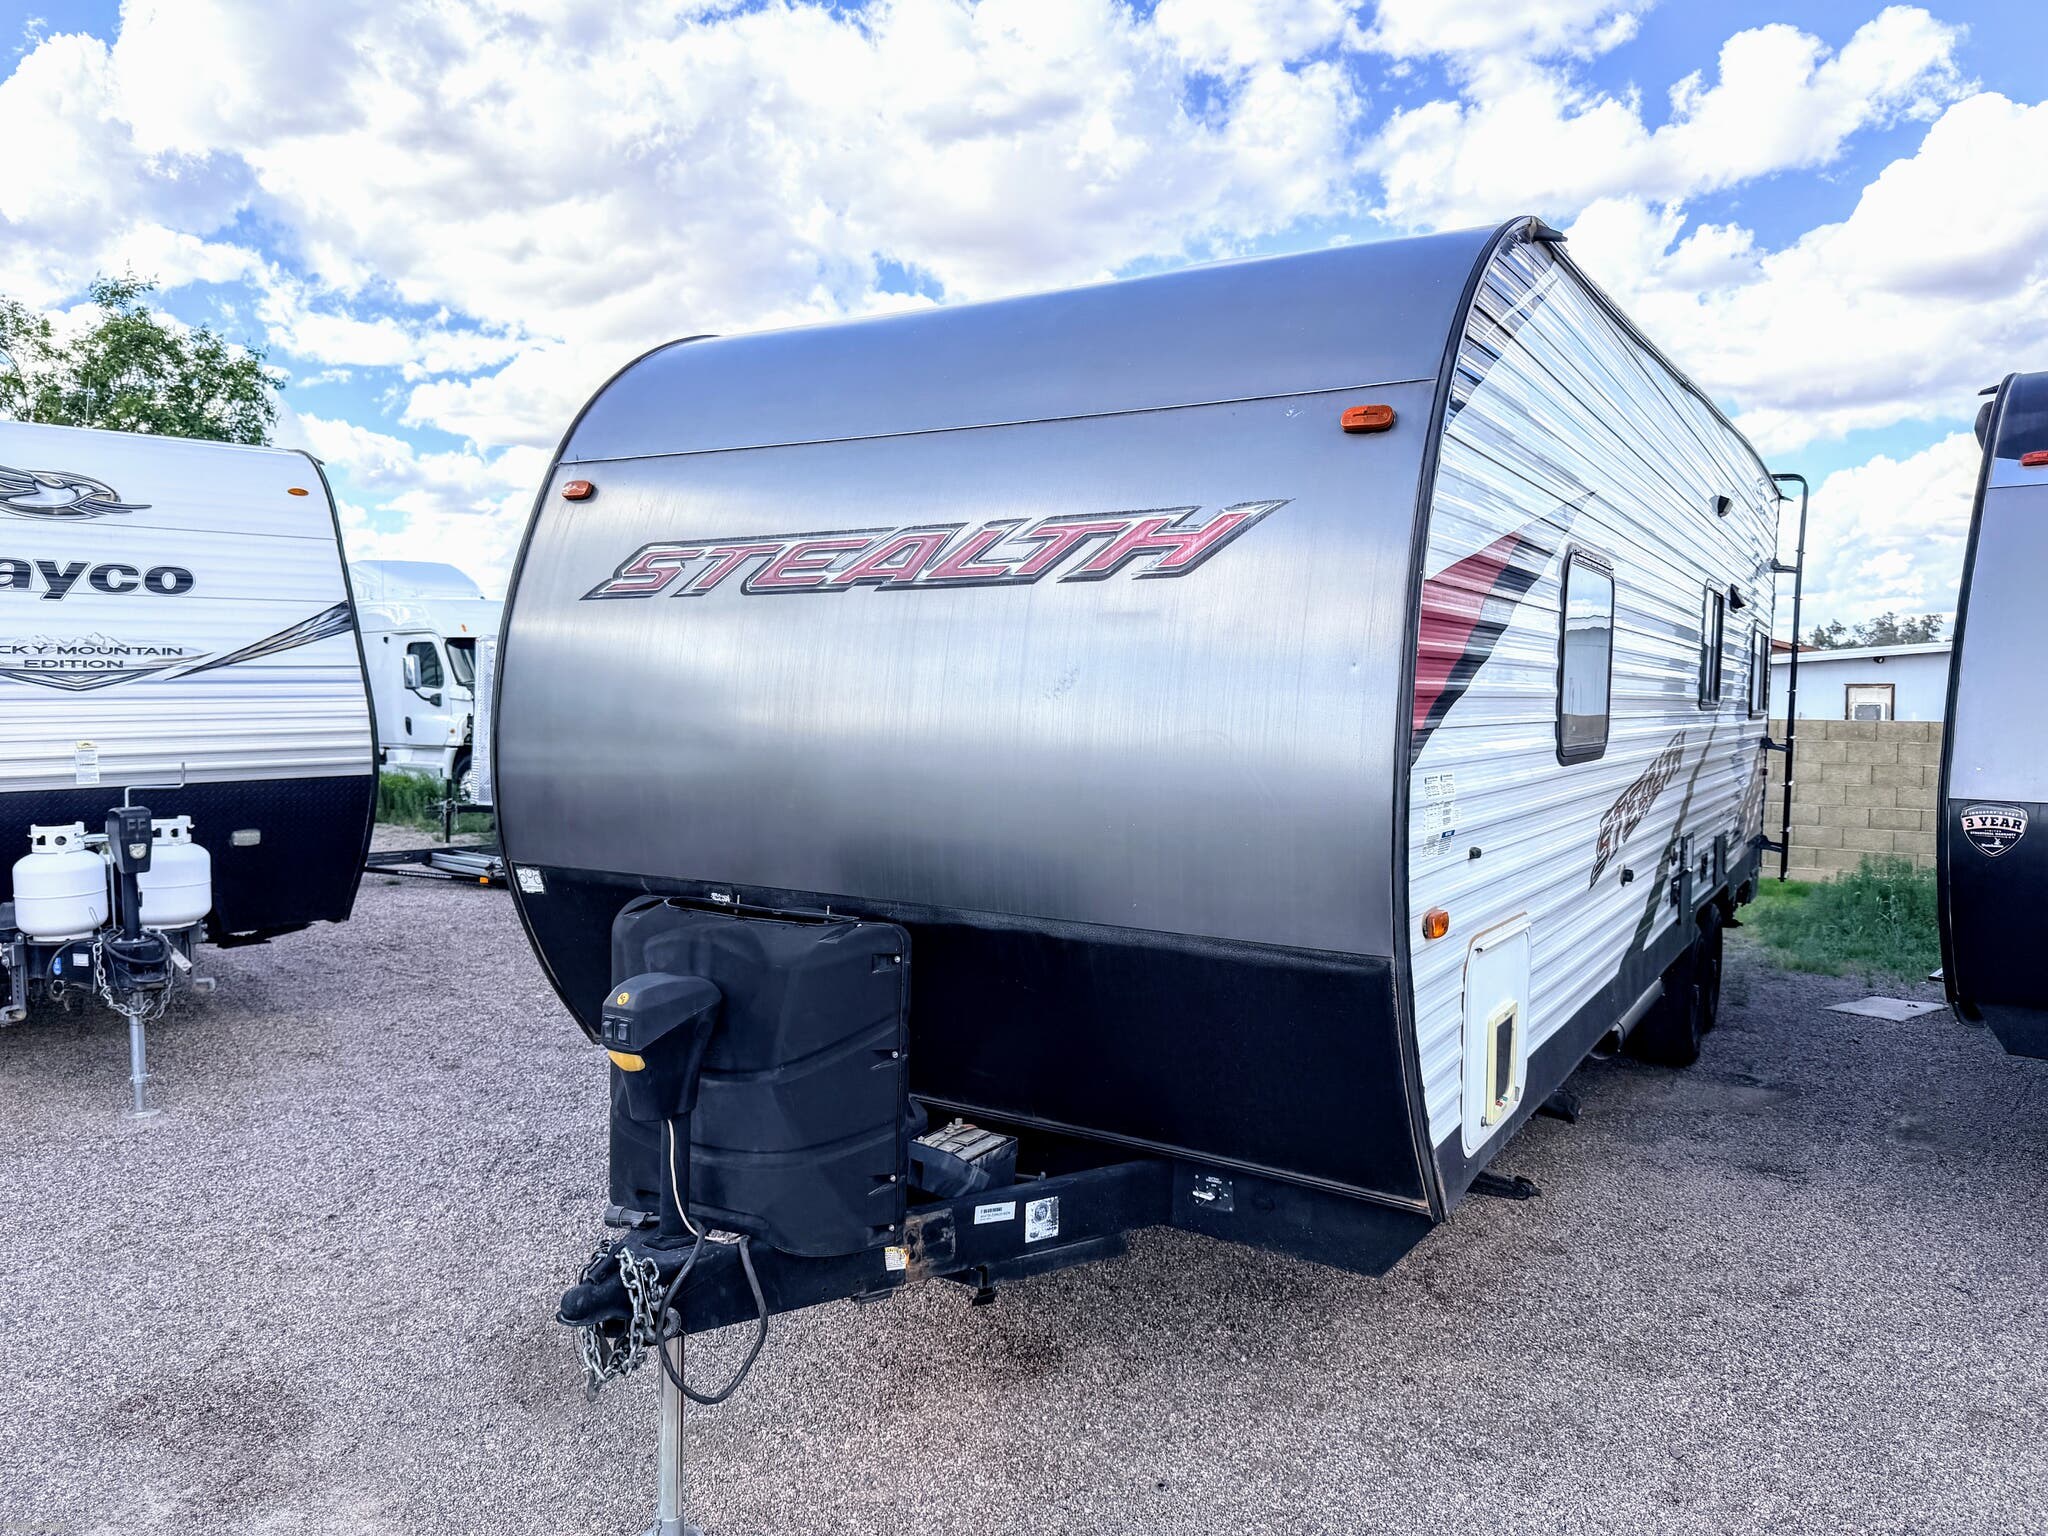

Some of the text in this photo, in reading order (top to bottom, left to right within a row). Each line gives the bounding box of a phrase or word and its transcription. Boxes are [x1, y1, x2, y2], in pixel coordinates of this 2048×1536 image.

[580, 498, 1296, 600] STEALTH
[57, 646, 183, 656] MOUNTAIN
[24, 659, 124, 669] EDITION
[1965, 816, 2022, 830] 3 YEAR
